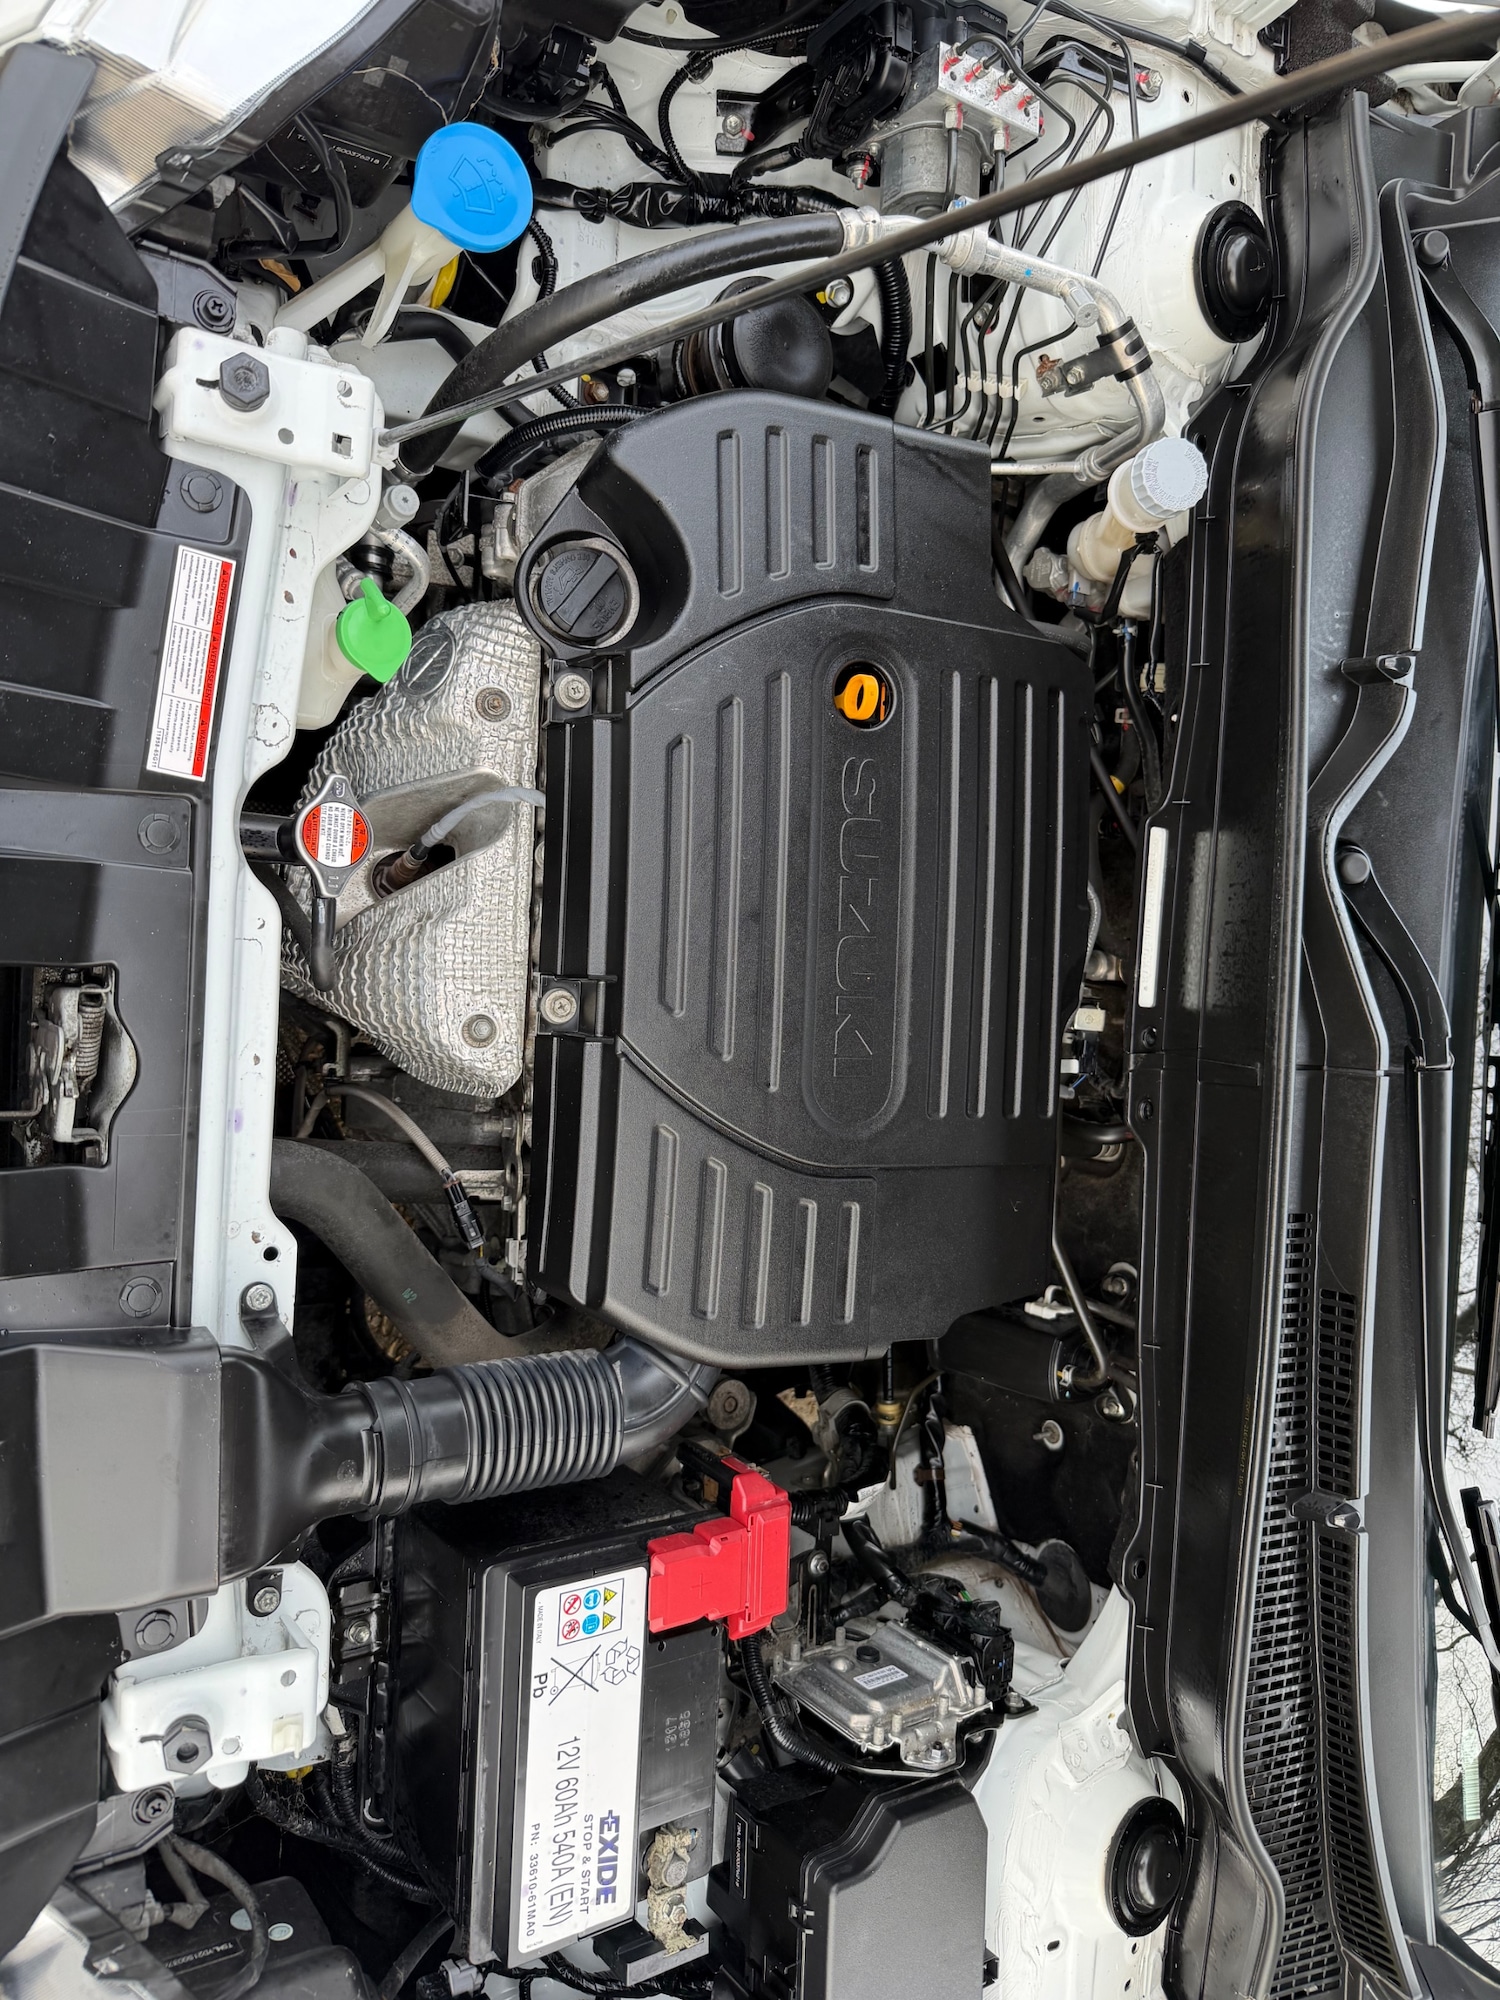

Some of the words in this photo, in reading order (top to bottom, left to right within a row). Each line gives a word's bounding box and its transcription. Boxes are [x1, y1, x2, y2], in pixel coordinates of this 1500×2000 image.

[215, 577, 227, 626] ADVERTENCIA
[204, 645, 217, 702] AVERTISSEMENT
[196, 728, 206, 762] WARNING
[834, 756, 880, 1081] SUZUKI
[532, 1672, 547, 1699] Pb
[556, 1735, 579, 1772] 12V
[552, 1776, 578, 1828] 60Ah
[530, 1822, 540, 1846] PN:
[550, 1829, 576, 1882] 540A
[582, 1812, 592, 1851] STOP
[581, 1854, 591, 1864] &
[595, 1807, 620, 1908] EXIDE
[525, 1853, 538, 1937] 33610-61MA0
[542, 1880, 574, 1929] (EN)
[579, 1868, 590, 1915] START
